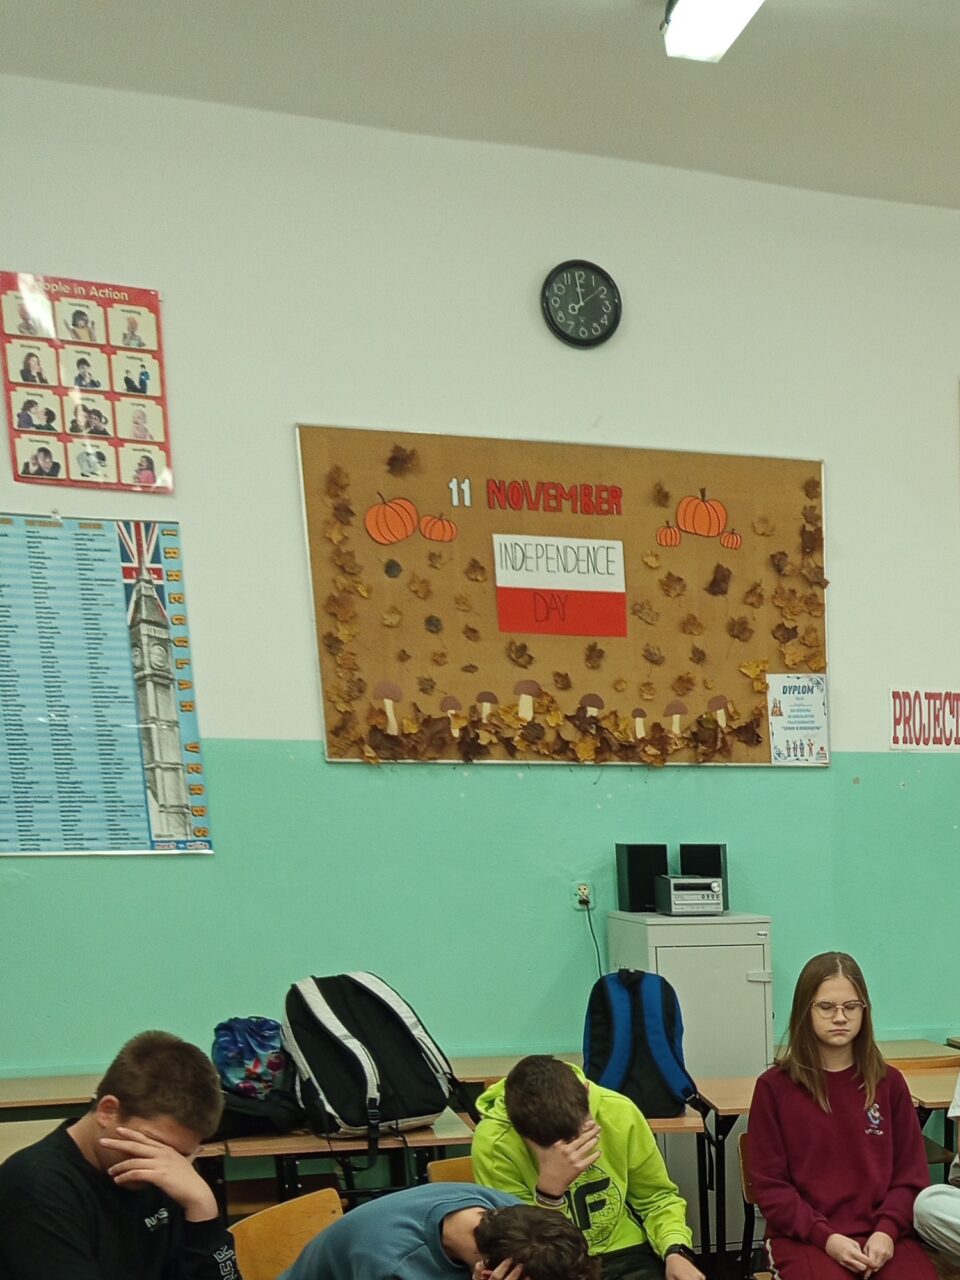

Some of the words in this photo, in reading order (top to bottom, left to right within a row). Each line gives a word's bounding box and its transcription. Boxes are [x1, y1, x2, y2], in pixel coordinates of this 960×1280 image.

[74, 283, 86, 296] in
[89, 286, 129, 301] Action
[448, 477, 472, 507] 11
[486, 478, 623, 516] NOVEMBER
[499, 541, 617, 576] INDEPENDENCE
[532, 591, 569, 623] DAY
[782, 685, 815, 695] DYPLOM
